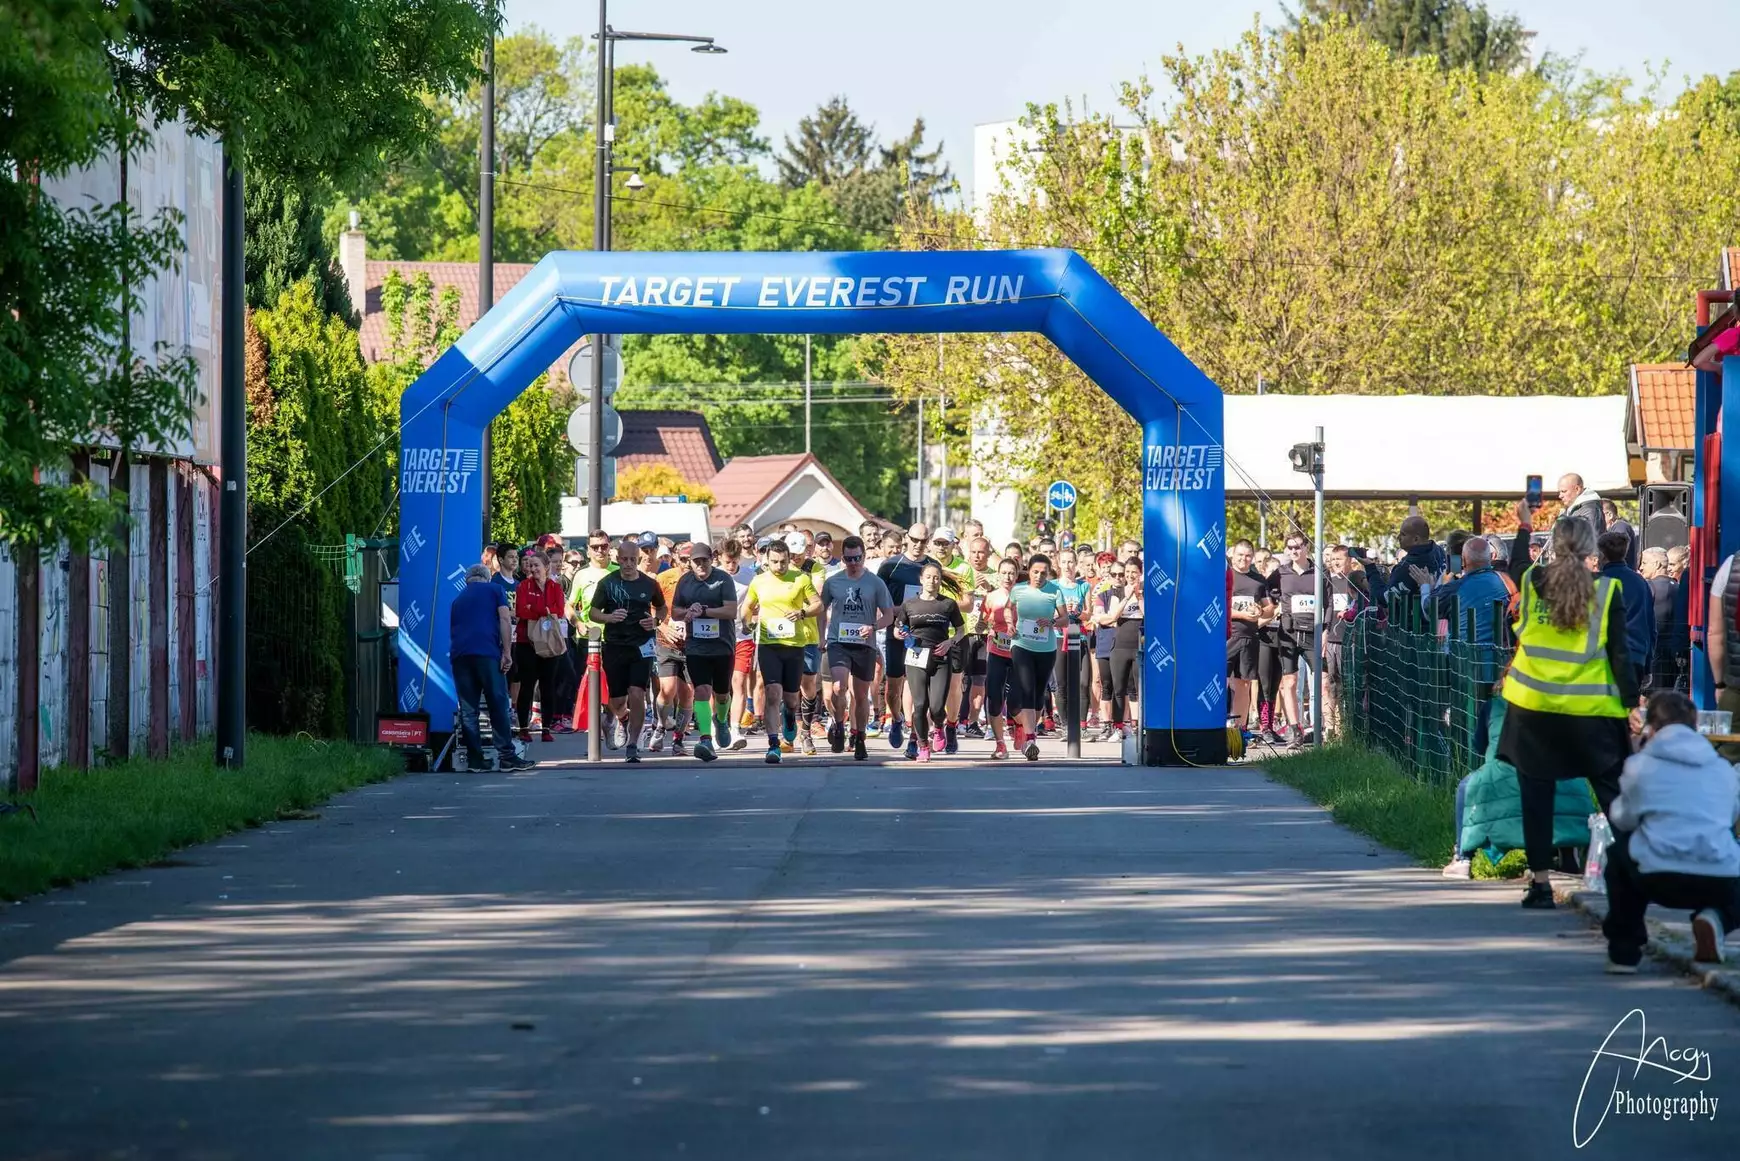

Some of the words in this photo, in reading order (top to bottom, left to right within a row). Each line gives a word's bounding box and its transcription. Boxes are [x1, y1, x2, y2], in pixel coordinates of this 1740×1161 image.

[600, 276, 741, 307] TARGET
[758, 275, 928, 307] EVEREST
[945, 275, 1025, 305] RUN
[403, 448, 464, 471] TARGET
[1147, 445, 1209, 468] TARGET
[402, 471, 471, 494] EVEREST
[1146, 468, 1216, 491] EVEREST
[700, 624, 711, 632] 12
[778, 623, 784, 631] 6
[1033, 626, 1039, 634] 8
